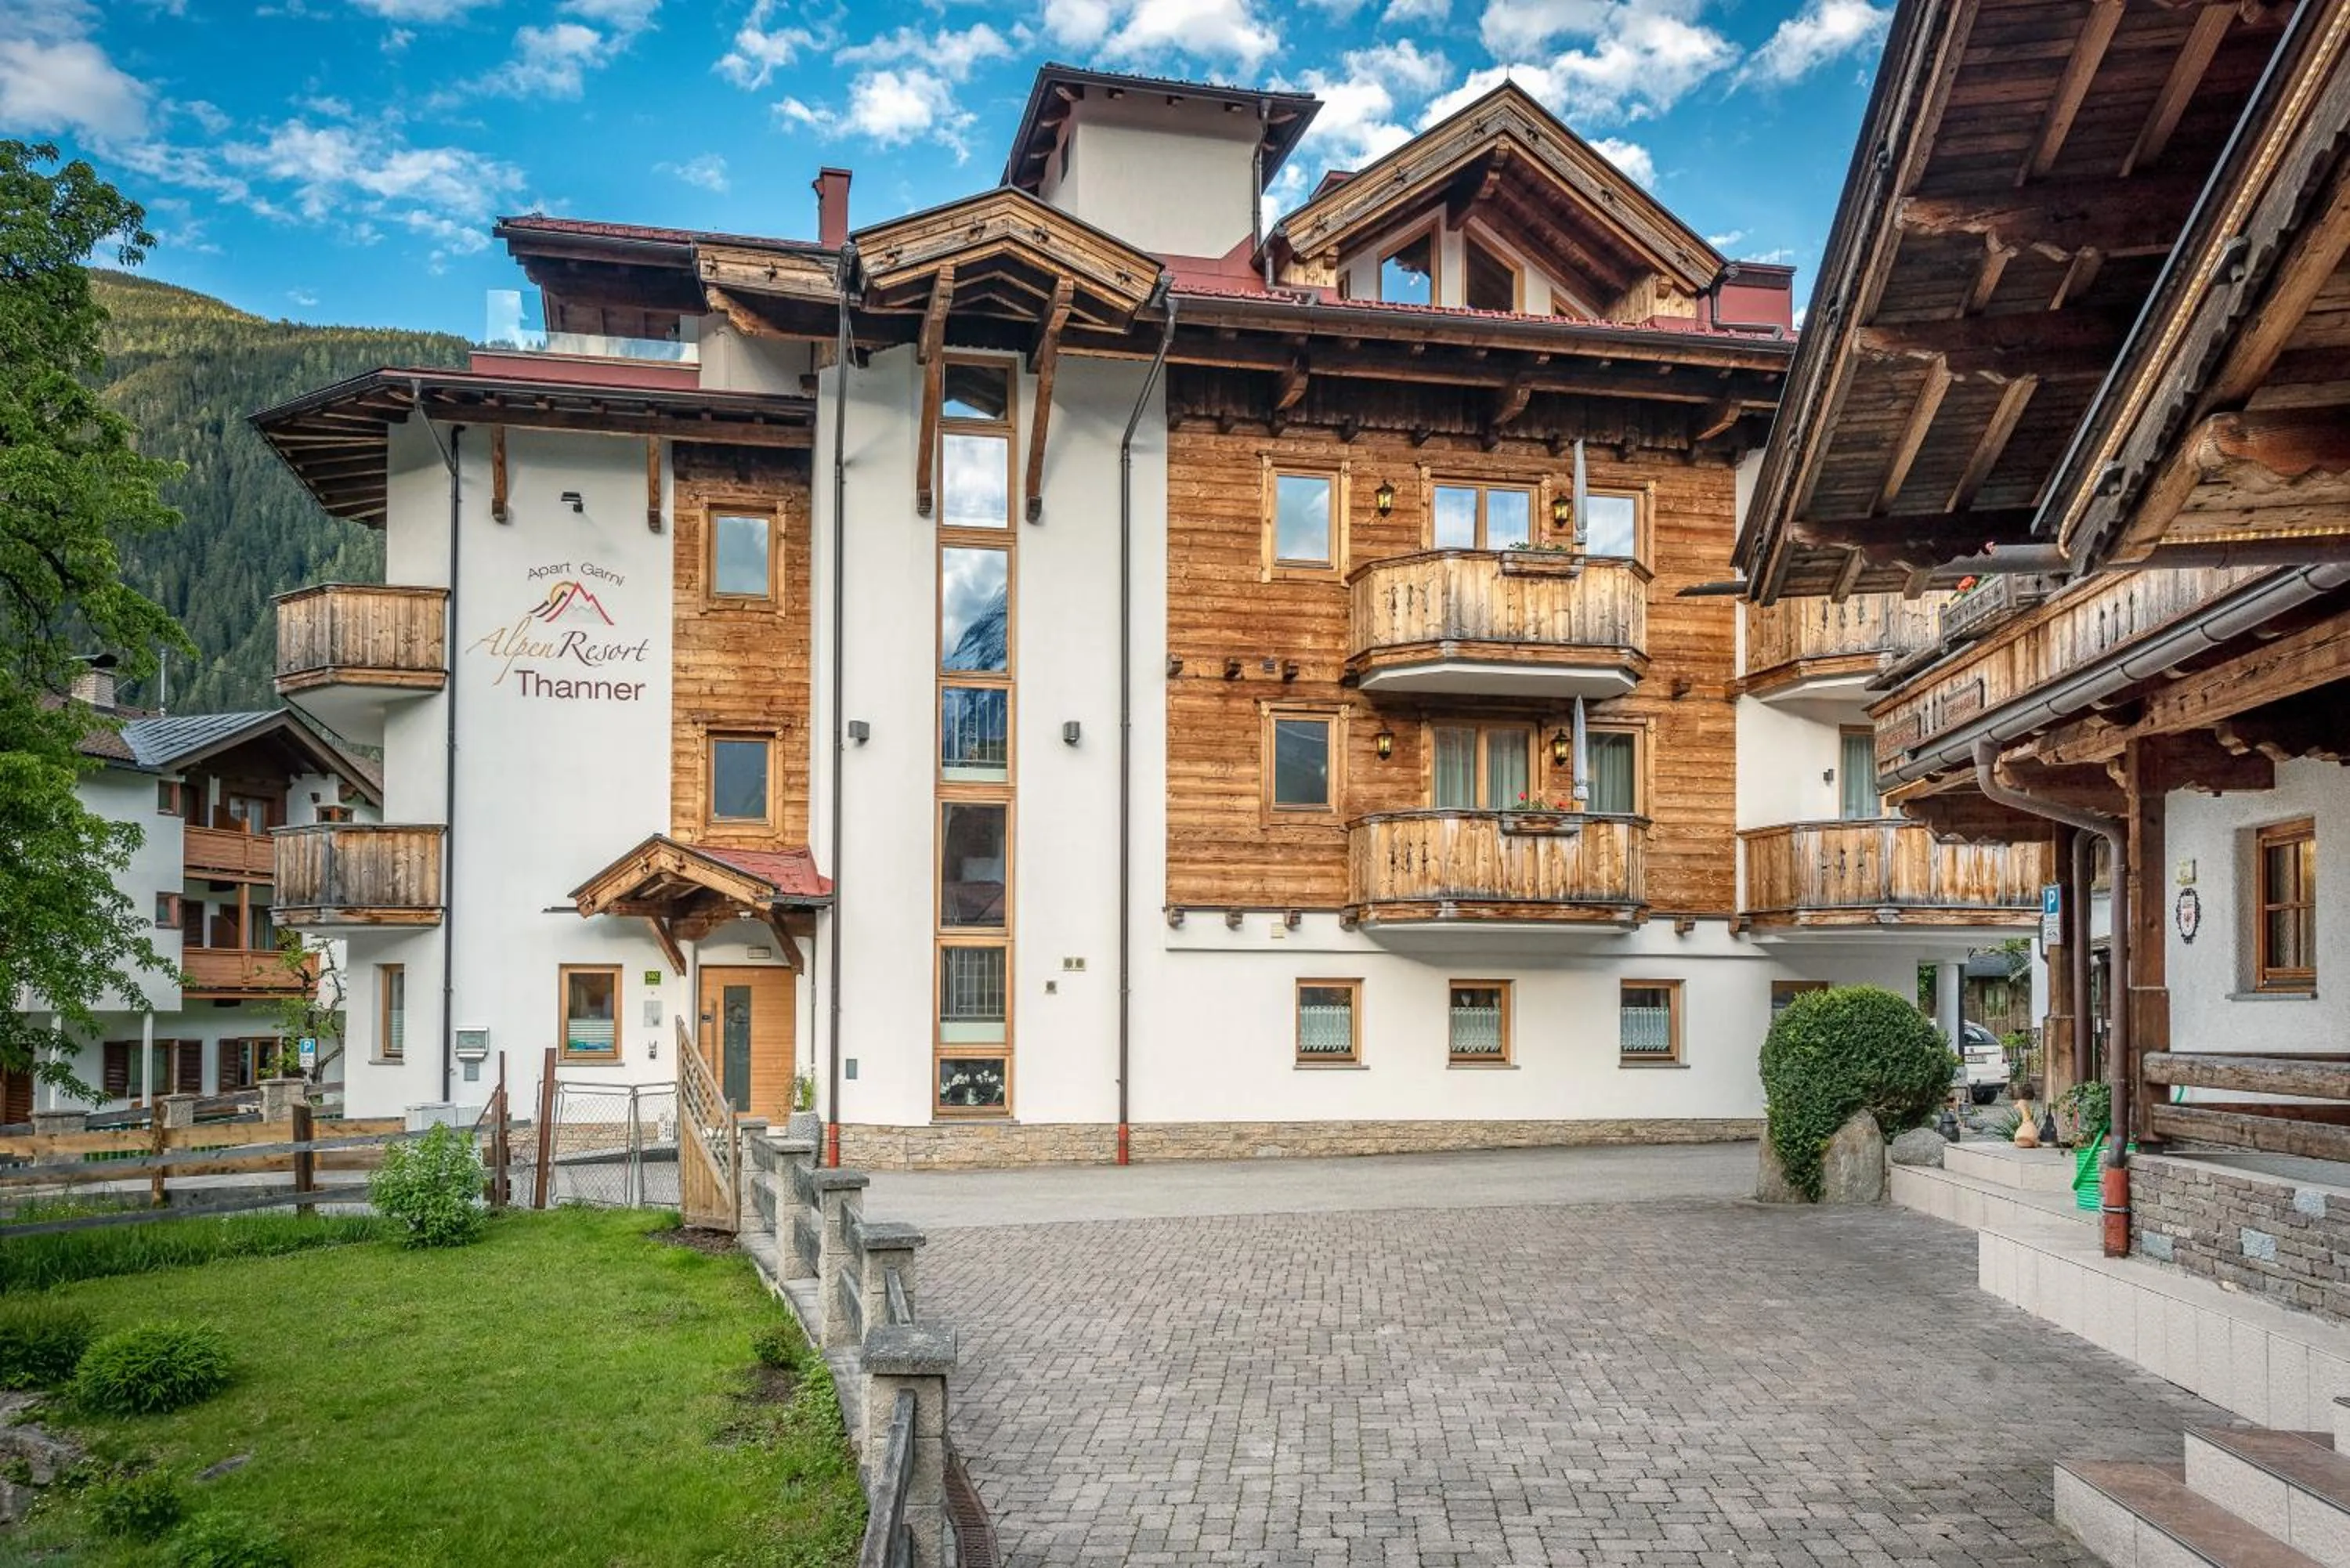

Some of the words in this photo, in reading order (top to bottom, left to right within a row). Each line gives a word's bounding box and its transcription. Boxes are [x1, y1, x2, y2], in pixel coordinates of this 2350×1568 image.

[527, 562, 570, 580] Apart
[580, 562, 626, 587] Garni
[514, 670, 646, 701] Thanner
[2048, 890, 2055, 912] P
[303, 1041, 312, 1051] P
